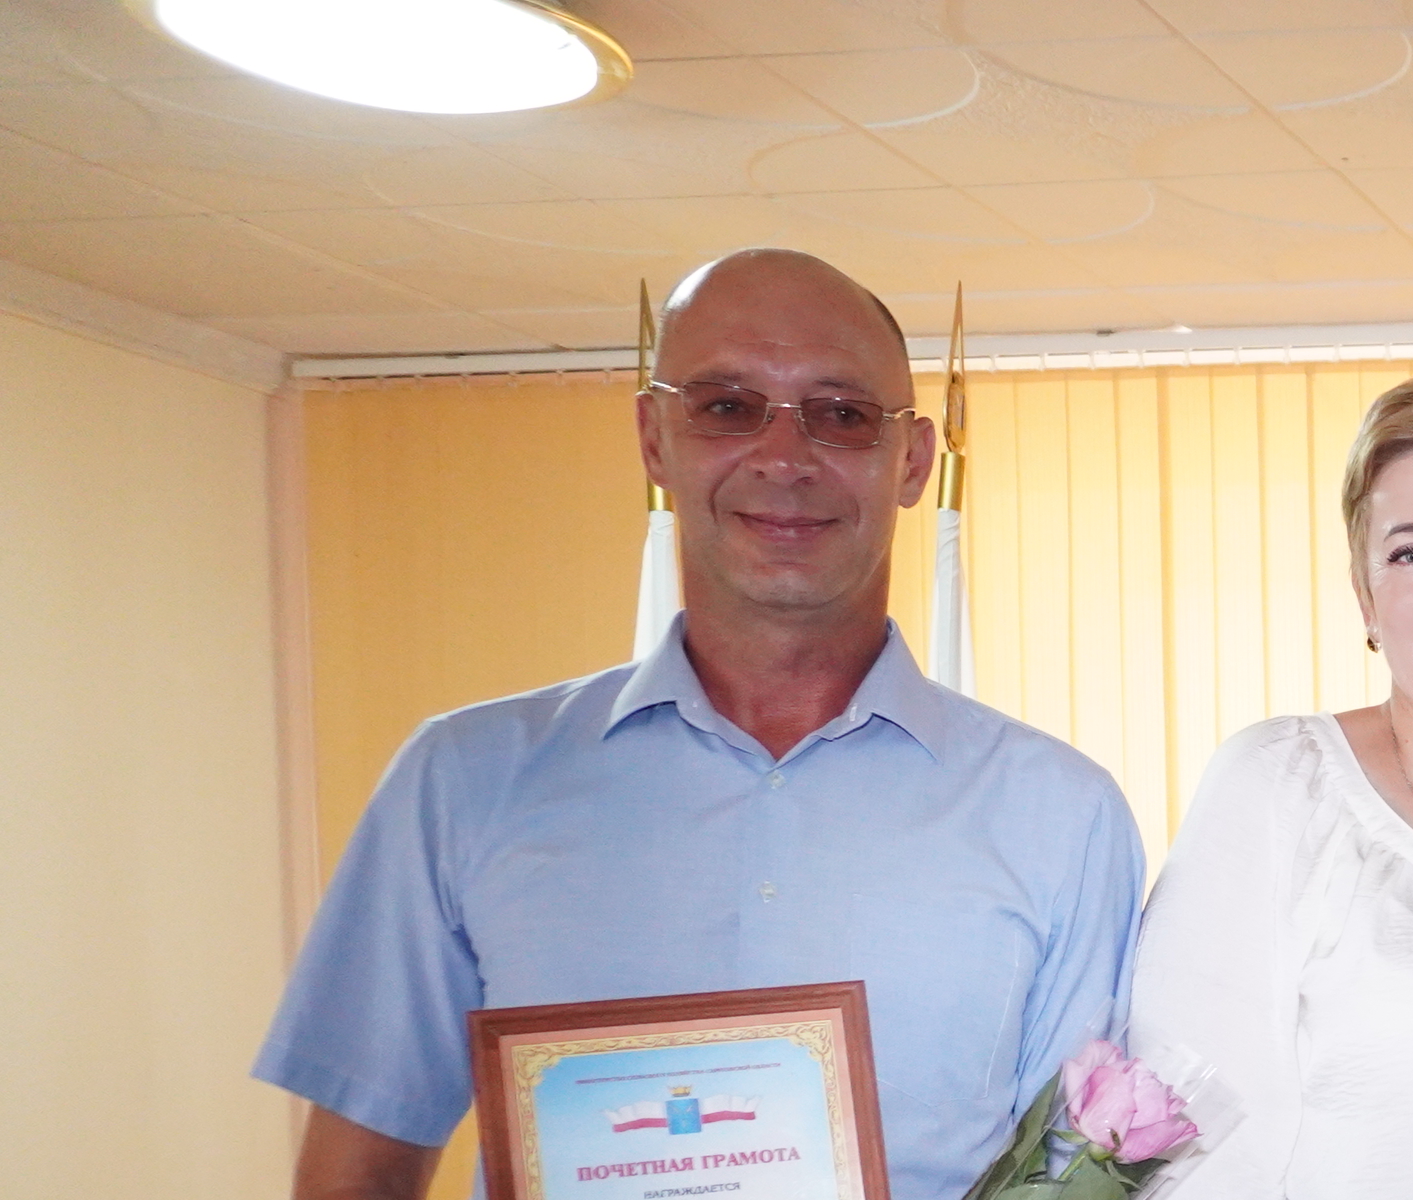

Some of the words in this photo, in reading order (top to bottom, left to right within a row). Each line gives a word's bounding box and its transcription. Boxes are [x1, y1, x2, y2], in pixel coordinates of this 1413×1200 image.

[576, 1157, 694, 1181] ПОЧЕТНАЯ
[700, 1146, 801, 1170] ГРАМОТА
[643, 1182, 741, 1200] НАГРАЖДАЕТСЯ
